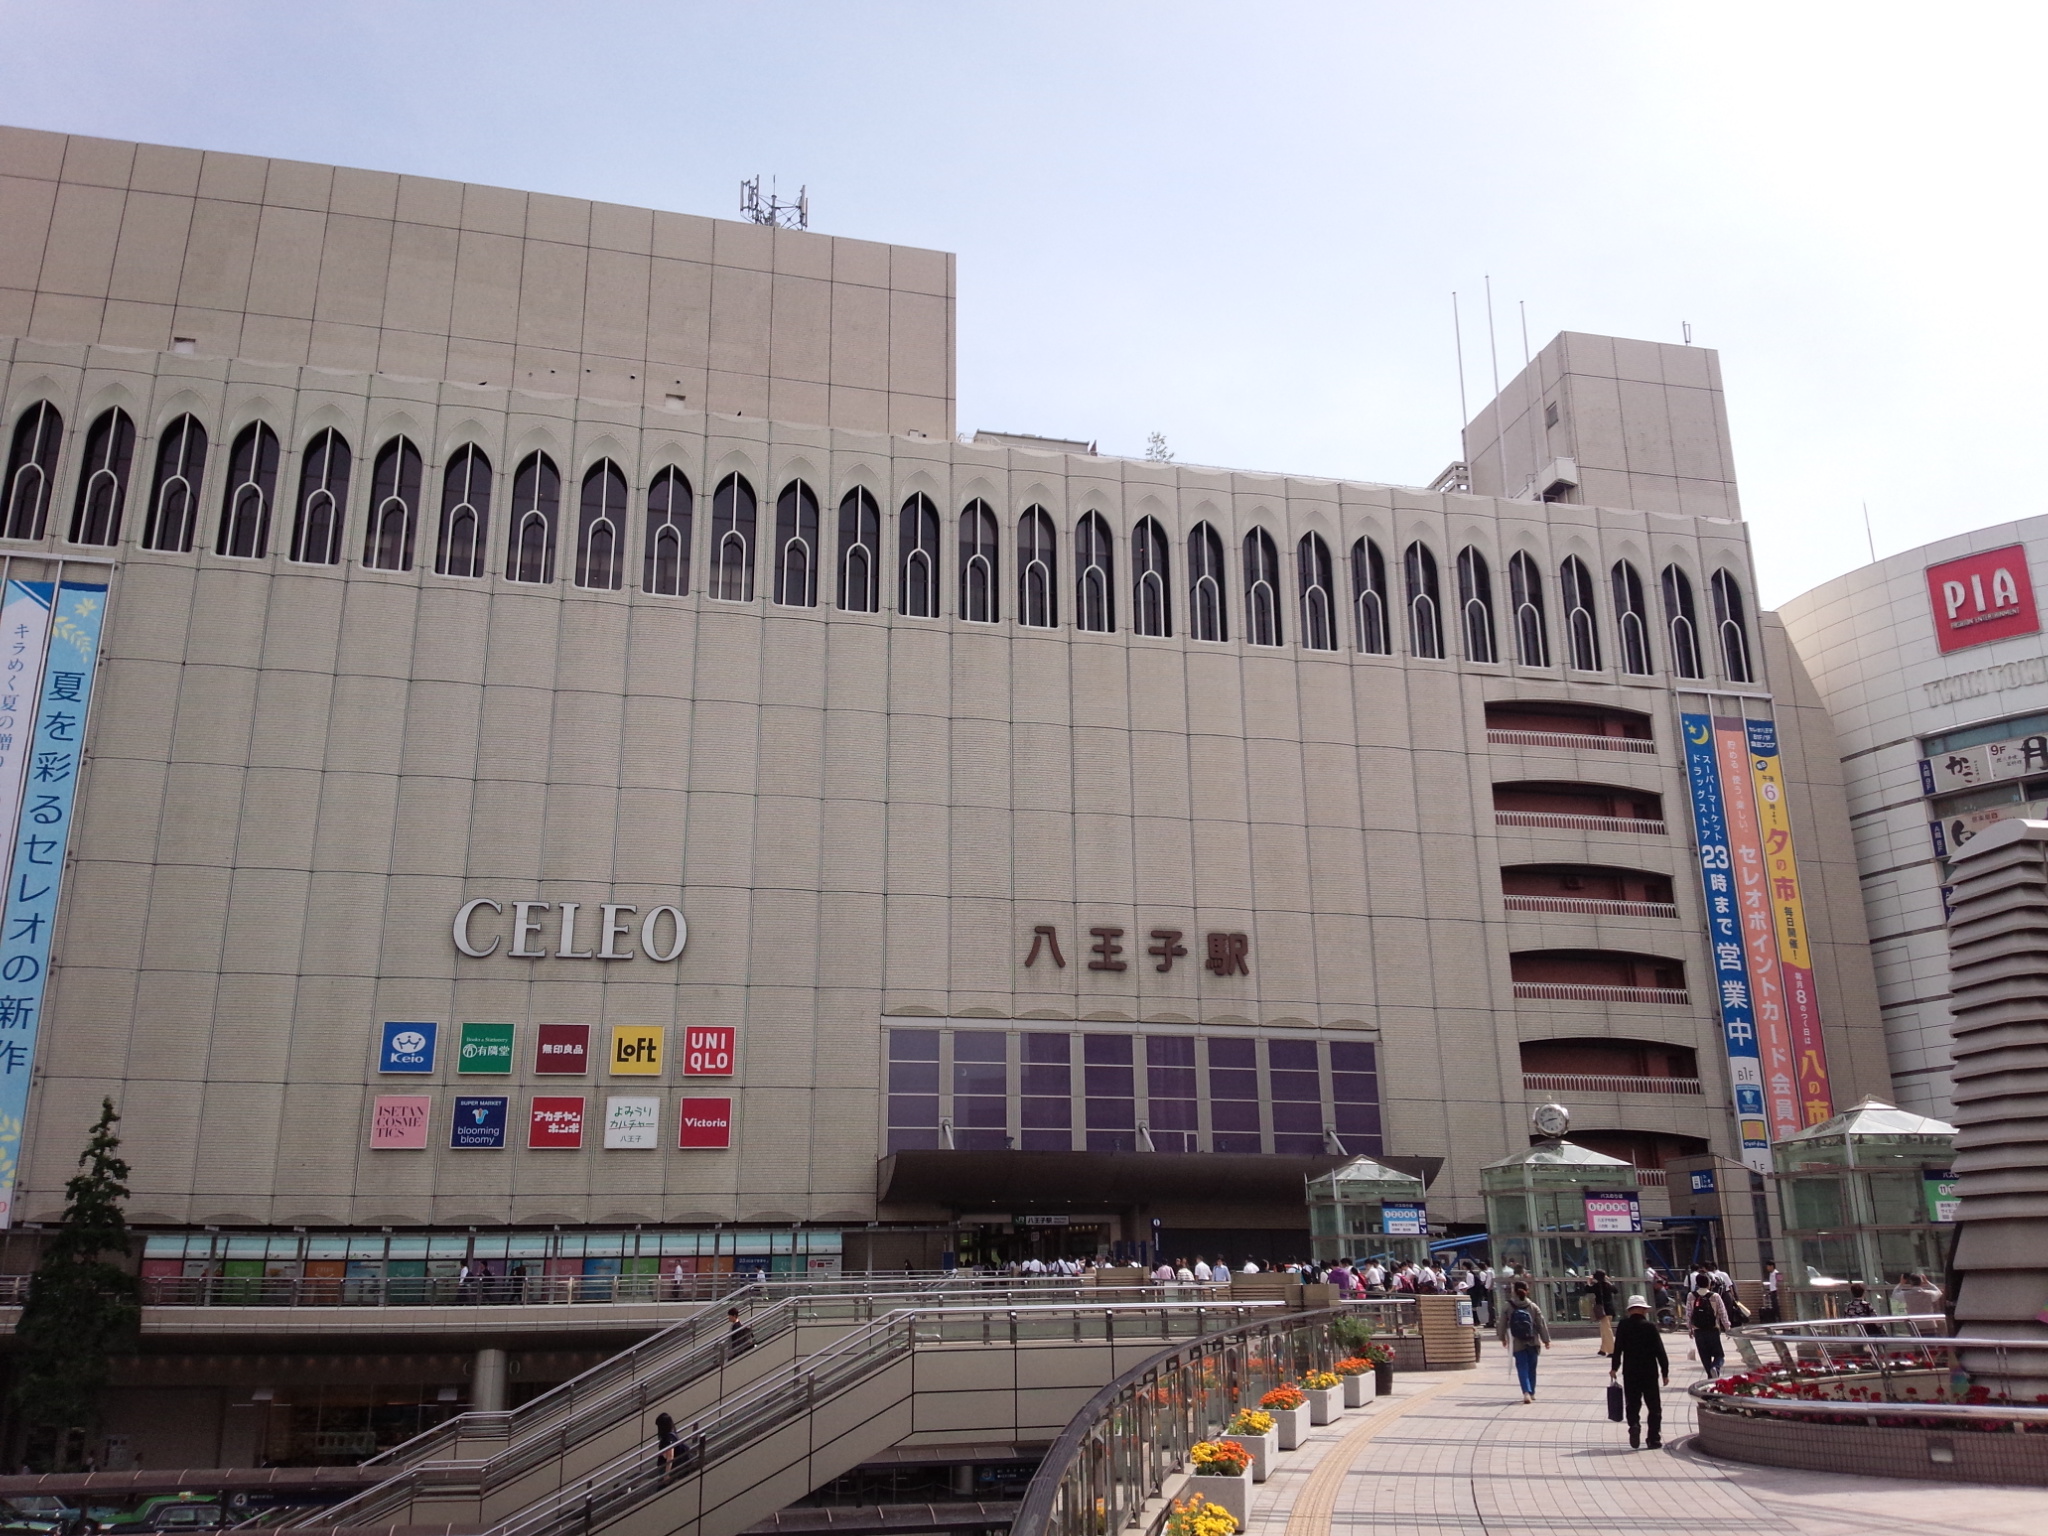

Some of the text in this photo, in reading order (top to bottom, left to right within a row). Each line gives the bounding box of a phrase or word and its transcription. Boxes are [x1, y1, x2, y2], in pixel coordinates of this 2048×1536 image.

[1943, 567, 2019, 620] PIA
[1975, 607, 2020, 624] ENTERTAINMENT
[1990, 744, 2006, 756] 9F
[1693, 754, 1711, 840] ドラッグストア
[1702, 755, 1723, 841] スーパーマーケット
[0, 670, 85, 1076] 夏を彩るセレオの新作
[452, 898, 688, 962] CELEO
[1024, 925, 1250, 977] 八王子駅
[1701, 844, 1753, 1047] 23時まで営業中
[691, 1032, 726, 1050] UNI
[478, 1045, 510, 1057] 有隣堂
[542, 1043, 584, 1055] 無印良品
[390, 1052, 425, 1064] Keio
[689, 1052, 729, 1072] QLO
[1738, 1066, 1755, 1081] B1F
[1801, 1049, 1830, 1125] 八の市
[379, 1105, 425, 1117] ISETAN
[534, 1111, 581, 1122] アカチャン
[614, 1105, 652, 1117] よみうり
[376, 1116, 422, 1127] COSME
[609, 1119, 655, 1131] カルチャー
[684, 1117, 727, 1128] Victoria
[375, 1127, 405, 1138] TICS
[457, 1126, 500, 1137] blooming
[460, 1135, 495, 1146] bloomy
[620, 1134, 643, 1143] 八王子
